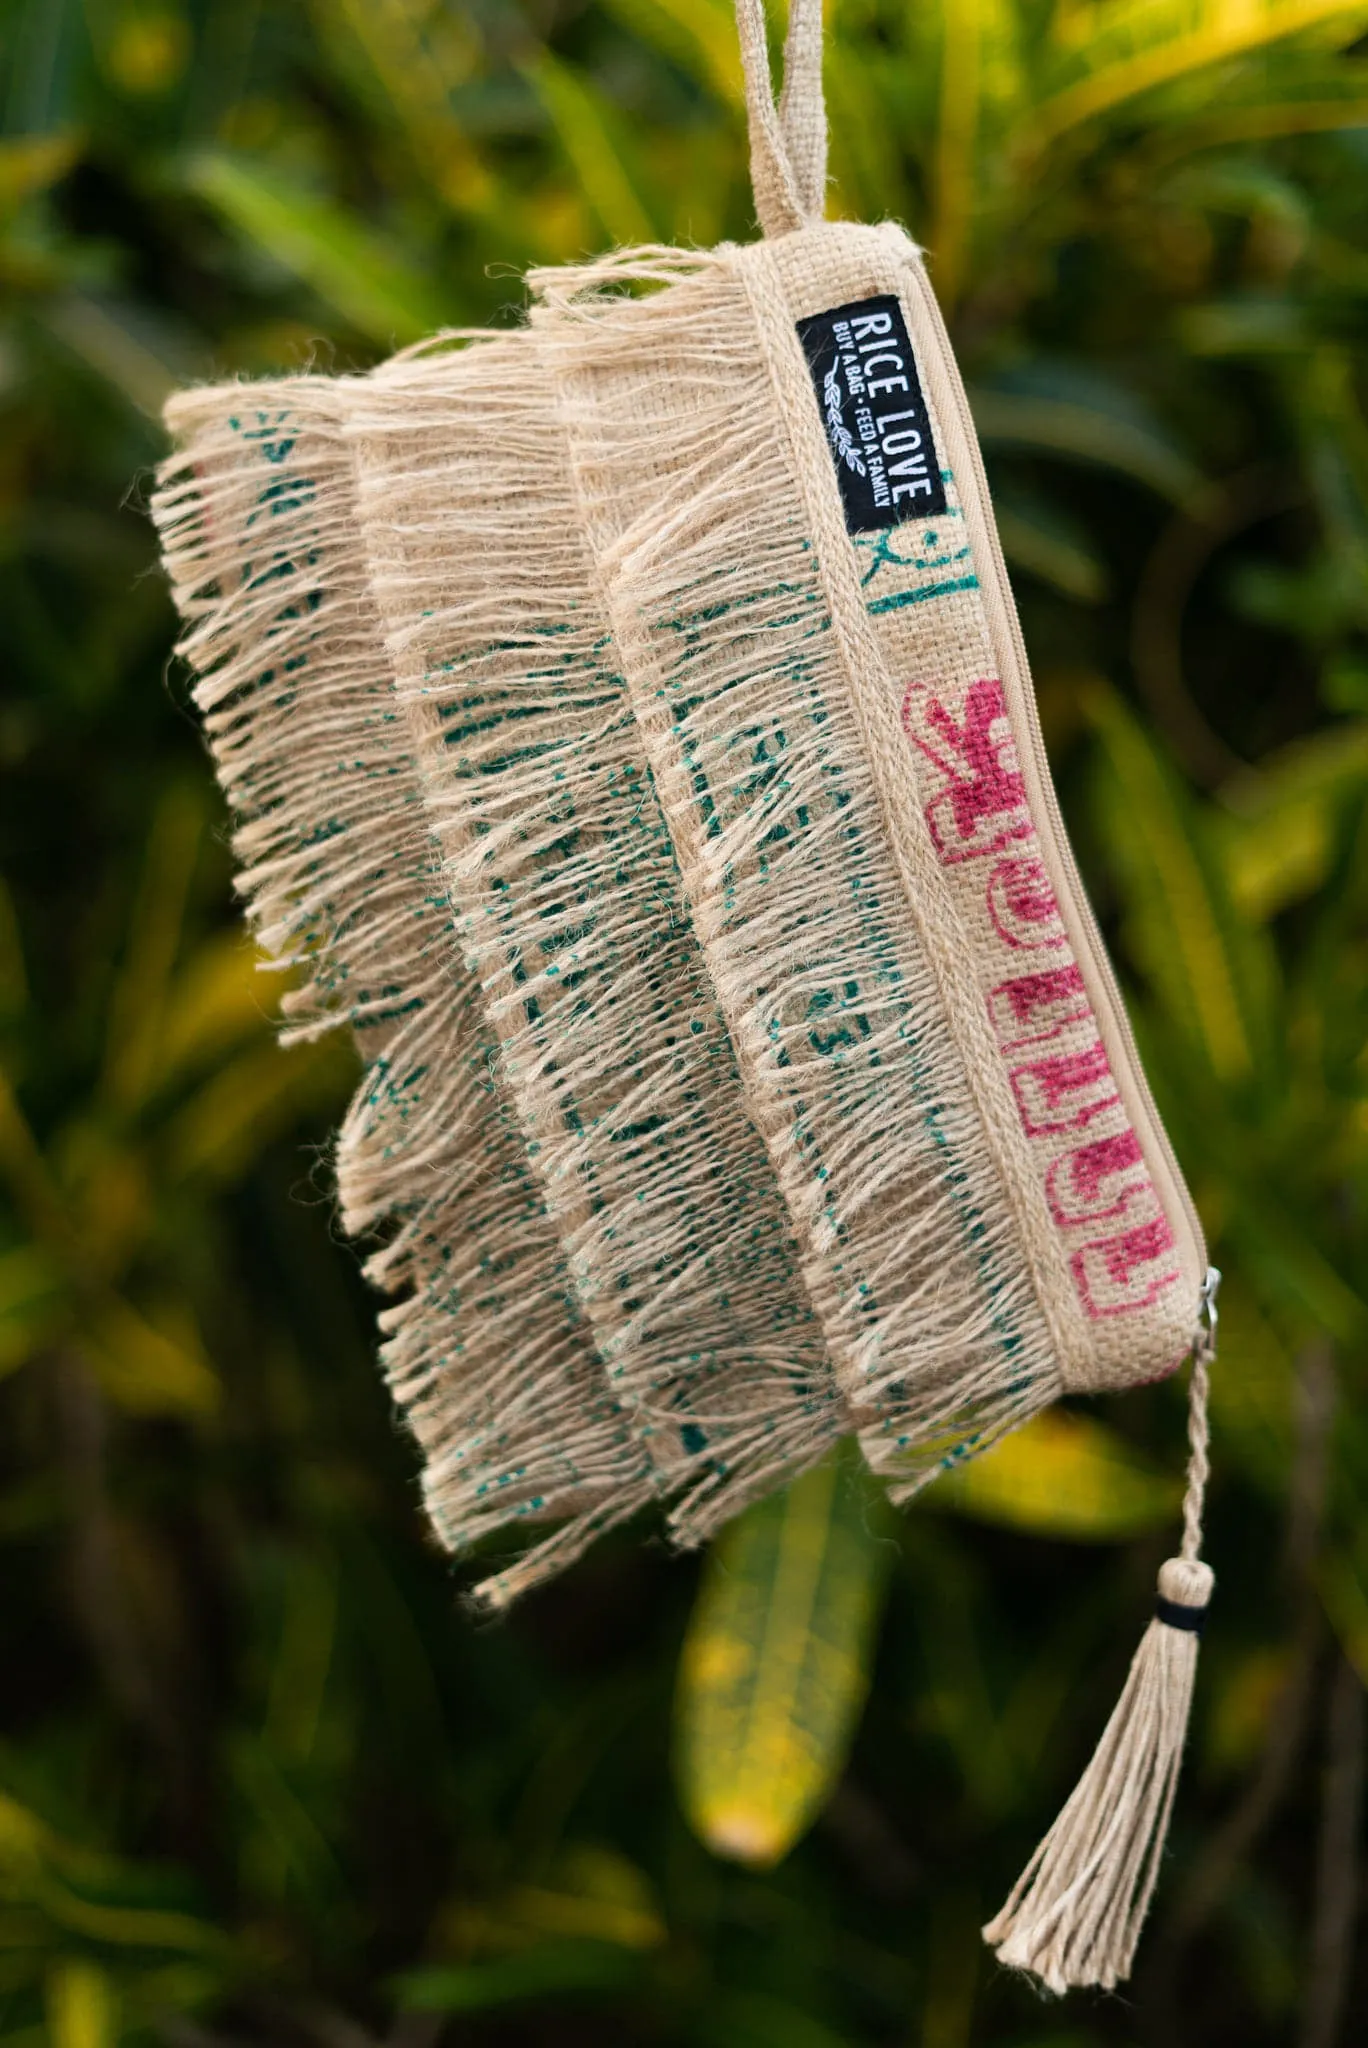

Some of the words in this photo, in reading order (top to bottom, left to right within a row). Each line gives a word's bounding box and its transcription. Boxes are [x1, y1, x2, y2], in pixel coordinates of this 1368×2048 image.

[832, 321, 854, 351] BUY
[841, 354, 858, 367] A
[850, 312, 910, 399] RICE
[845, 366, 866, 395] BAG
[854, 407, 876, 441] FEED
[863, 444, 877, 456] A
[876, 409, 932, 505] LOVE
[866, 456, 891, 508] FAMILY
